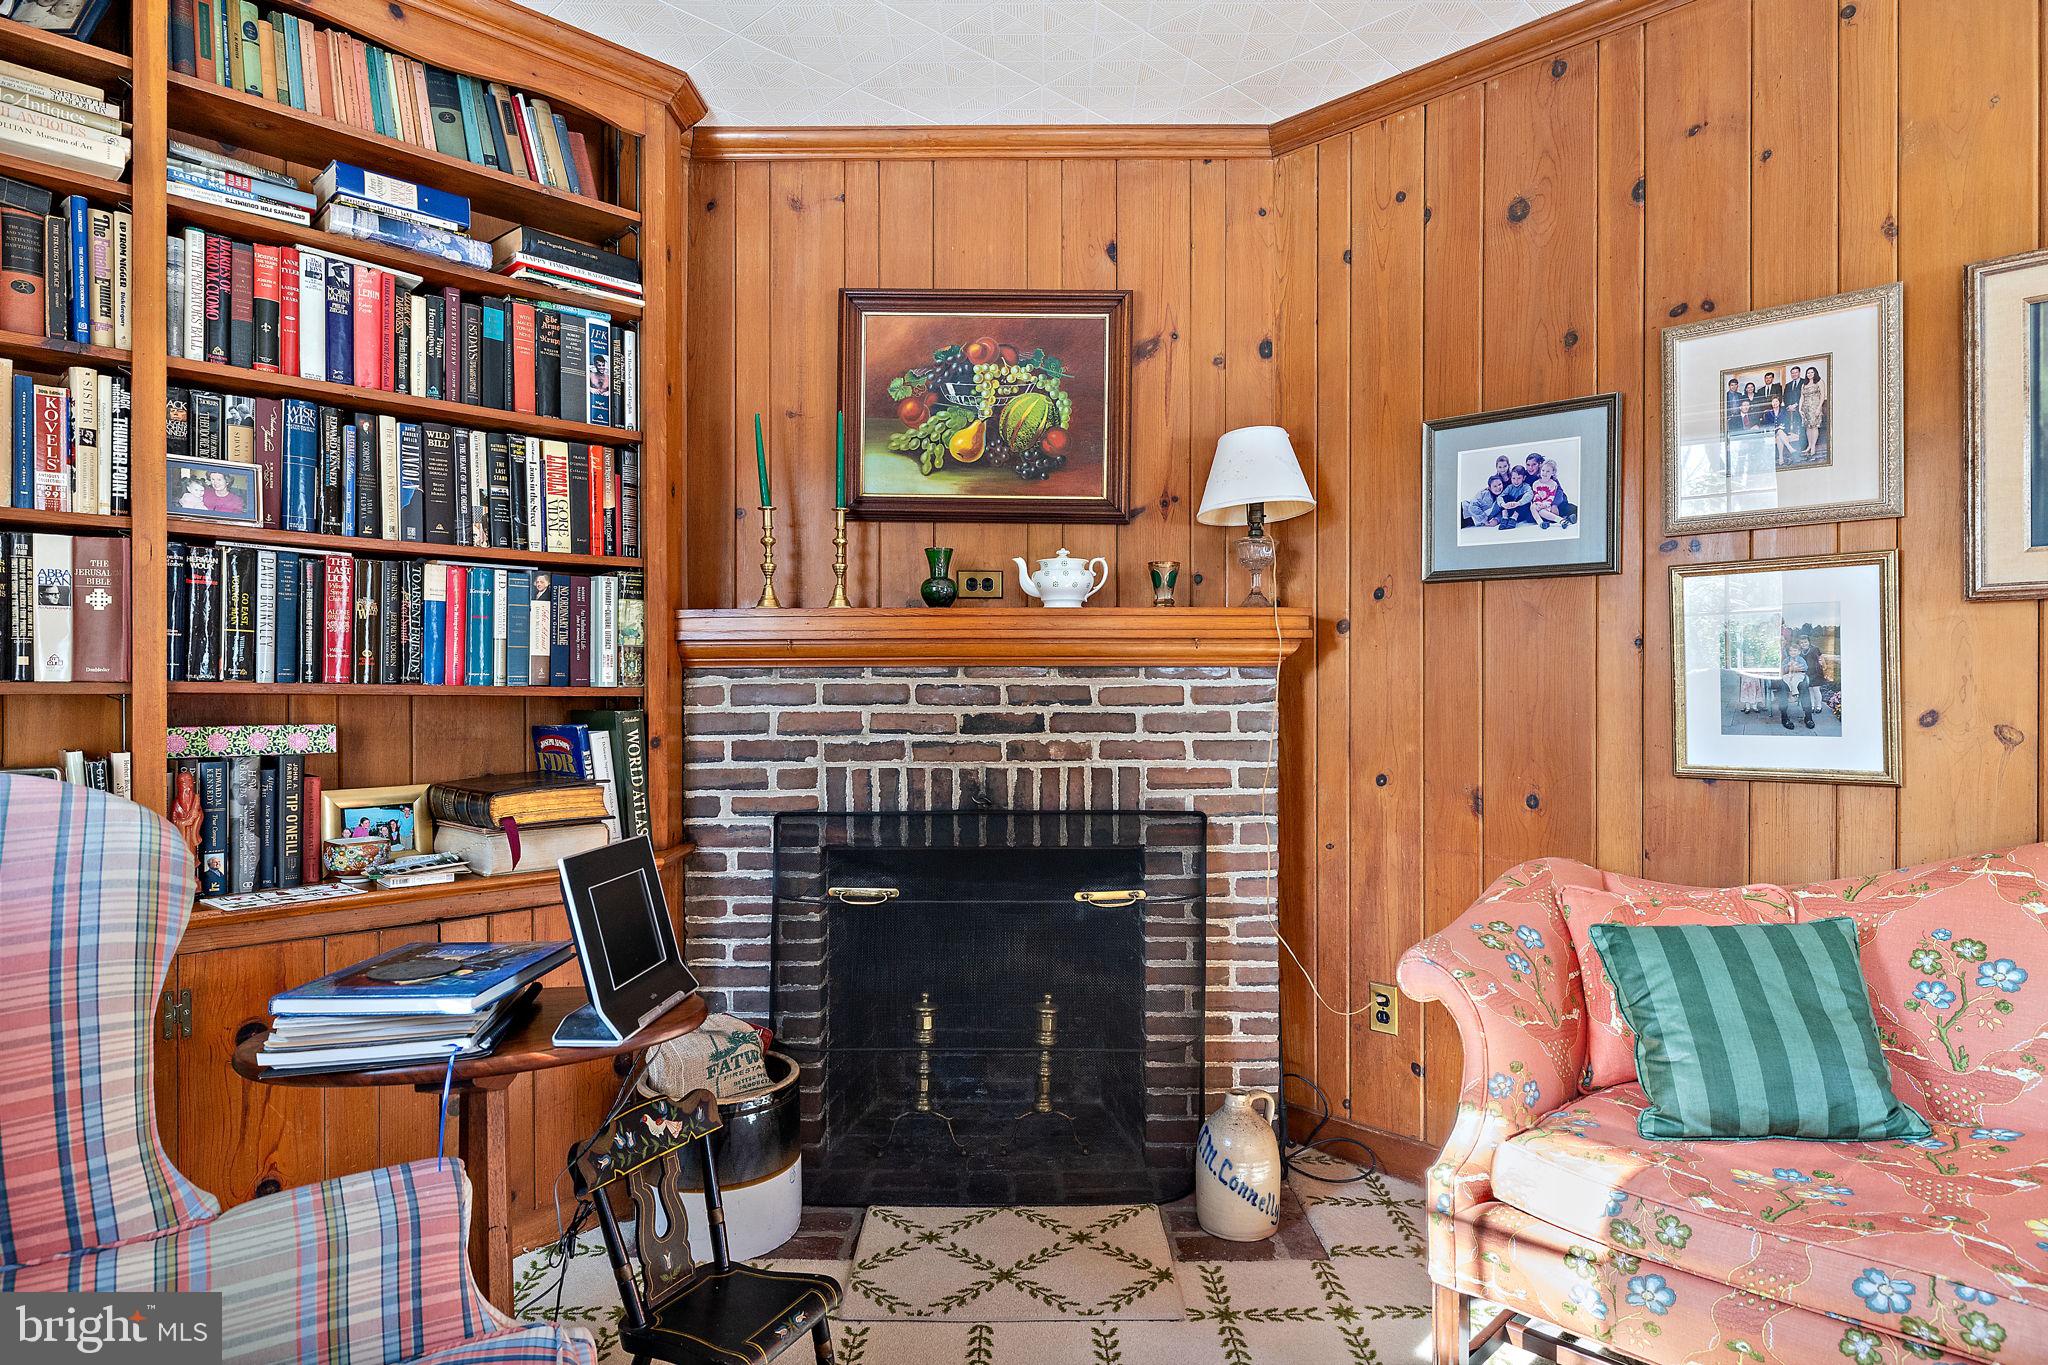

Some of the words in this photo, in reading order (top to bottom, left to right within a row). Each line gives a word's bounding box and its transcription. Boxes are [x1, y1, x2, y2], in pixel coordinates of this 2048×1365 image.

[14, 94, 86, 124] Antiques
[36, 130, 68, 144] Museum
[80, 142, 93, 150] Art
[174, 140, 184, 150] NO
[173, 171, 205, 184] LARRY
[94, 215, 110, 238] The
[119, 222, 128, 232] UP
[119, 233, 128, 256] FROM
[206, 237, 220, 269] MARIO
[54, 262, 59, 270] OF
[93, 236, 111, 278] Female
[191, 250, 203, 271] THE
[220, 239, 232, 279] DIARIES
[282, 258, 299, 266] ANNE
[119, 257, 128, 288] NIGGER
[206, 271, 220, 283] M.
[281, 268, 300, 276] TYLER
[220, 280, 232, 294] OF
[357, 290, 380, 302] LENIN
[206, 284, 220, 320] CUOMO
[118, 304, 126, 326] Gregory
[396, 295, 404, 334] DARKNESS
[544, 314, 558, 324] The
[191, 327, 203, 350] BALL
[426, 307, 436, 358] Hemingway
[548, 330, 554, 338] of
[591, 328, 608, 340] JFK
[399, 336, 408, 354] Helen
[436, 338, 444, 358] Papa
[468, 336, 478, 360] DAYS
[613, 340, 621, 358] WHILE
[613, 357, 621, 380] REAGAN
[613, 380, 621, 396] SLEPT
[83, 380, 92, 424] SISTER
[112, 384, 120, 413] HIGGINS
[121, 389, 130, 410] JACK
[166, 400, 188, 411] ACK
[288, 405, 316, 420] WISE
[288, 414, 316, 427] MEN
[200, 412, 210, 448] THEODORE
[329, 416, 338, 450] EDWARD
[426, 430, 451, 440] WILD
[112, 417, 128, 466] THUNDER
[346, 430, 355, 459] BASEBALL
[428, 439, 449, 449] BILL
[362, 440, 370, 472] SCORPIONS
[329, 450, 338, 488] KENNEDY
[402, 444, 420, 490] LINCOLN
[530, 461, 538, 483] Lions
[546, 454, 568, 498] LINCOLN
[112, 466, 128, 500] POINT
[386, 476, 394, 492] JOHN
[460, 474, 467, 482] OF
[493, 474, 508, 482] STAND
[530, 484, 538, 492] in
[460, 484, 468, 495] THE
[530, 492, 538, 504] the
[460, 496, 468, 514] ORDER
[530, 504, 538, 528] Street
[548, 499, 559, 536] VIDAL
[558, 499, 570, 537] GORE
[90, 560, 110, 568] THE
[186, 556, 218, 564] HERMAN
[190, 562, 214, 570] WOUK
[327, 566, 351, 574] LAST
[330, 558, 350, 566] THE
[38, 568, 72, 578] ABBA
[38, 577, 72, 586] EBAN
[74, 568, 116, 577] JERUSAL
[86, 578, 112, 586] BIBLE
[260, 558, 274, 590] DAVID
[327, 574, 351, 583] LION
[390, 568, 398, 582] THE
[411, 566, 422, 580] TO
[241, 592, 249, 604] GO
[390, 584, 398, 602] NINE
[470, 588, 492, 596] Kennedy
[560, 585, 568, 596] NO
[604, 582, 612, 606] DICTIONARY
[411, 580, 422, 626] ABSENT
[560, 596, 568, 629] ORDINARY
[580, 608, 586, 616] An
[241, 606, 249, 626] EAST,
[260, 594, 273, 648] BRINKLEY
[390, 611, 398, 638] JEFFREY
[560, 630, 568, 646] TIME
[604, 630, 612, 651] LITERACY
[390, 640, 398, 667] TOOBIN
[411, 626, 422, 672] FRIENDS
[538, 752, 576, 774] FDR
[626, 728, 644, 787] WORLD
[206, 768, 214, 806] KENNEDY
[240, 764, 248, 798] BRANDS
[286, 794, 298, 812] TIP
[632, 790, 649, 836] ATLAS
[286, 814, 298, 856] O'NEILL
